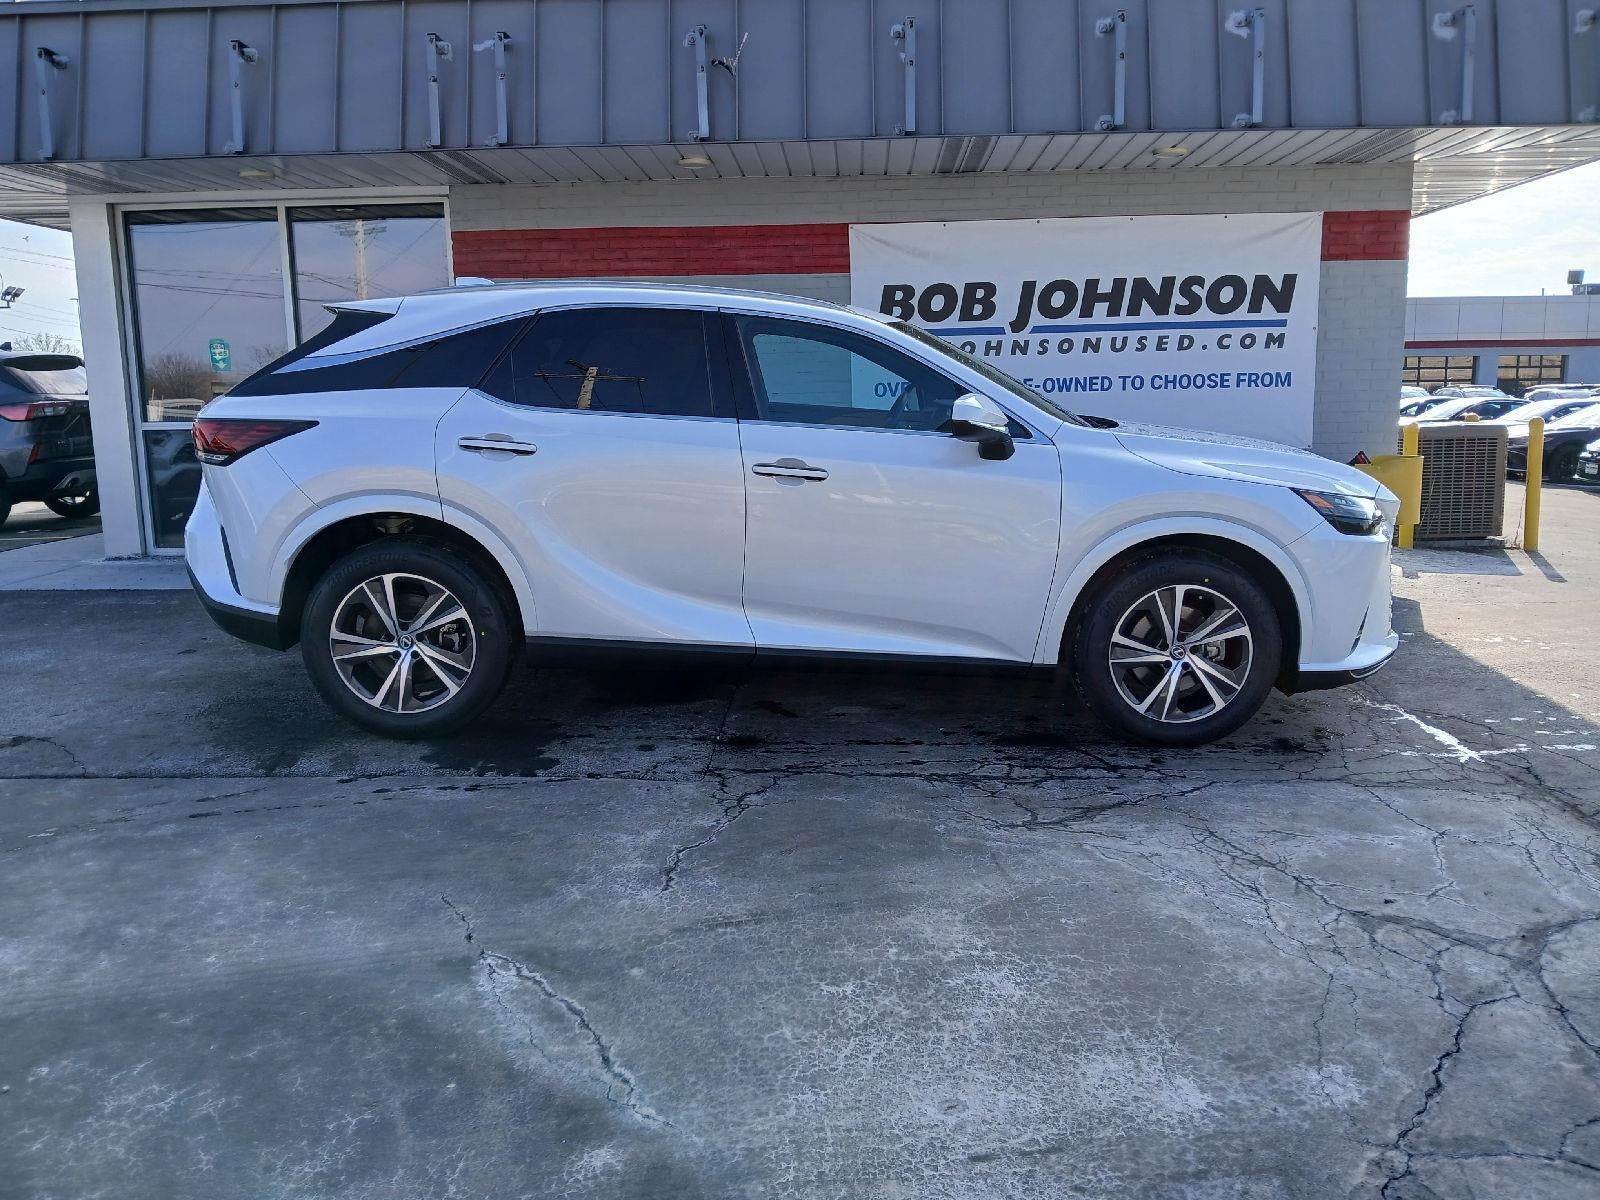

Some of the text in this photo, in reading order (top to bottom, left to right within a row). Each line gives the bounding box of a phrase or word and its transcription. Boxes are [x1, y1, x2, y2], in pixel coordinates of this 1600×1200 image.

[879, 273, 1298, 334] BOB JOHNSON
[947, 332, 1286, 357] OHNSONUSED.COM
[1118, 374, 1145, 392] TO
[1150, 372, 1231, 391] CHOOSE
[1236, 371, 1292, 389] FROM
